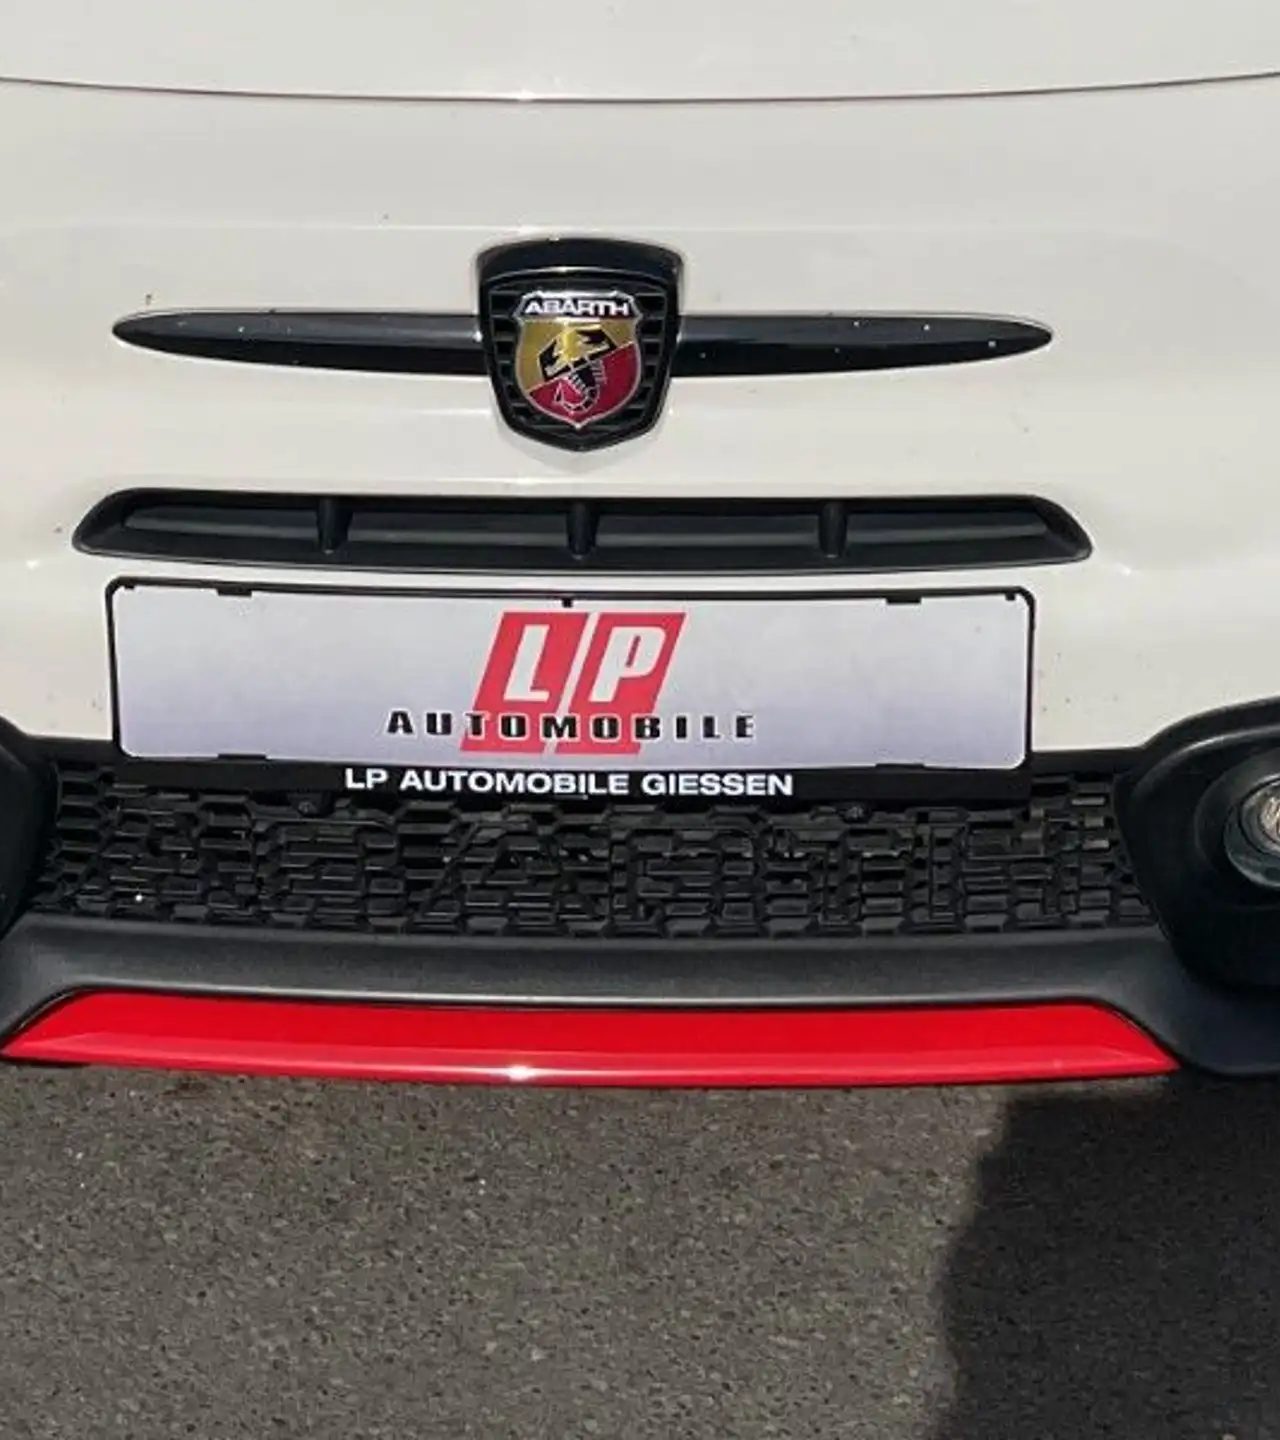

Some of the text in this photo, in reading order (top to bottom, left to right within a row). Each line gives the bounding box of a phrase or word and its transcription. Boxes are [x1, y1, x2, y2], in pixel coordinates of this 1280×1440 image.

[524, 299, 629, 315] ABARTH
[503, 623, 667, 702] LP
[385, 709, 755, 741] AUTOMOBILE
[345, 768, 794, 797] LP AUTOMOBILE GIESSEN
